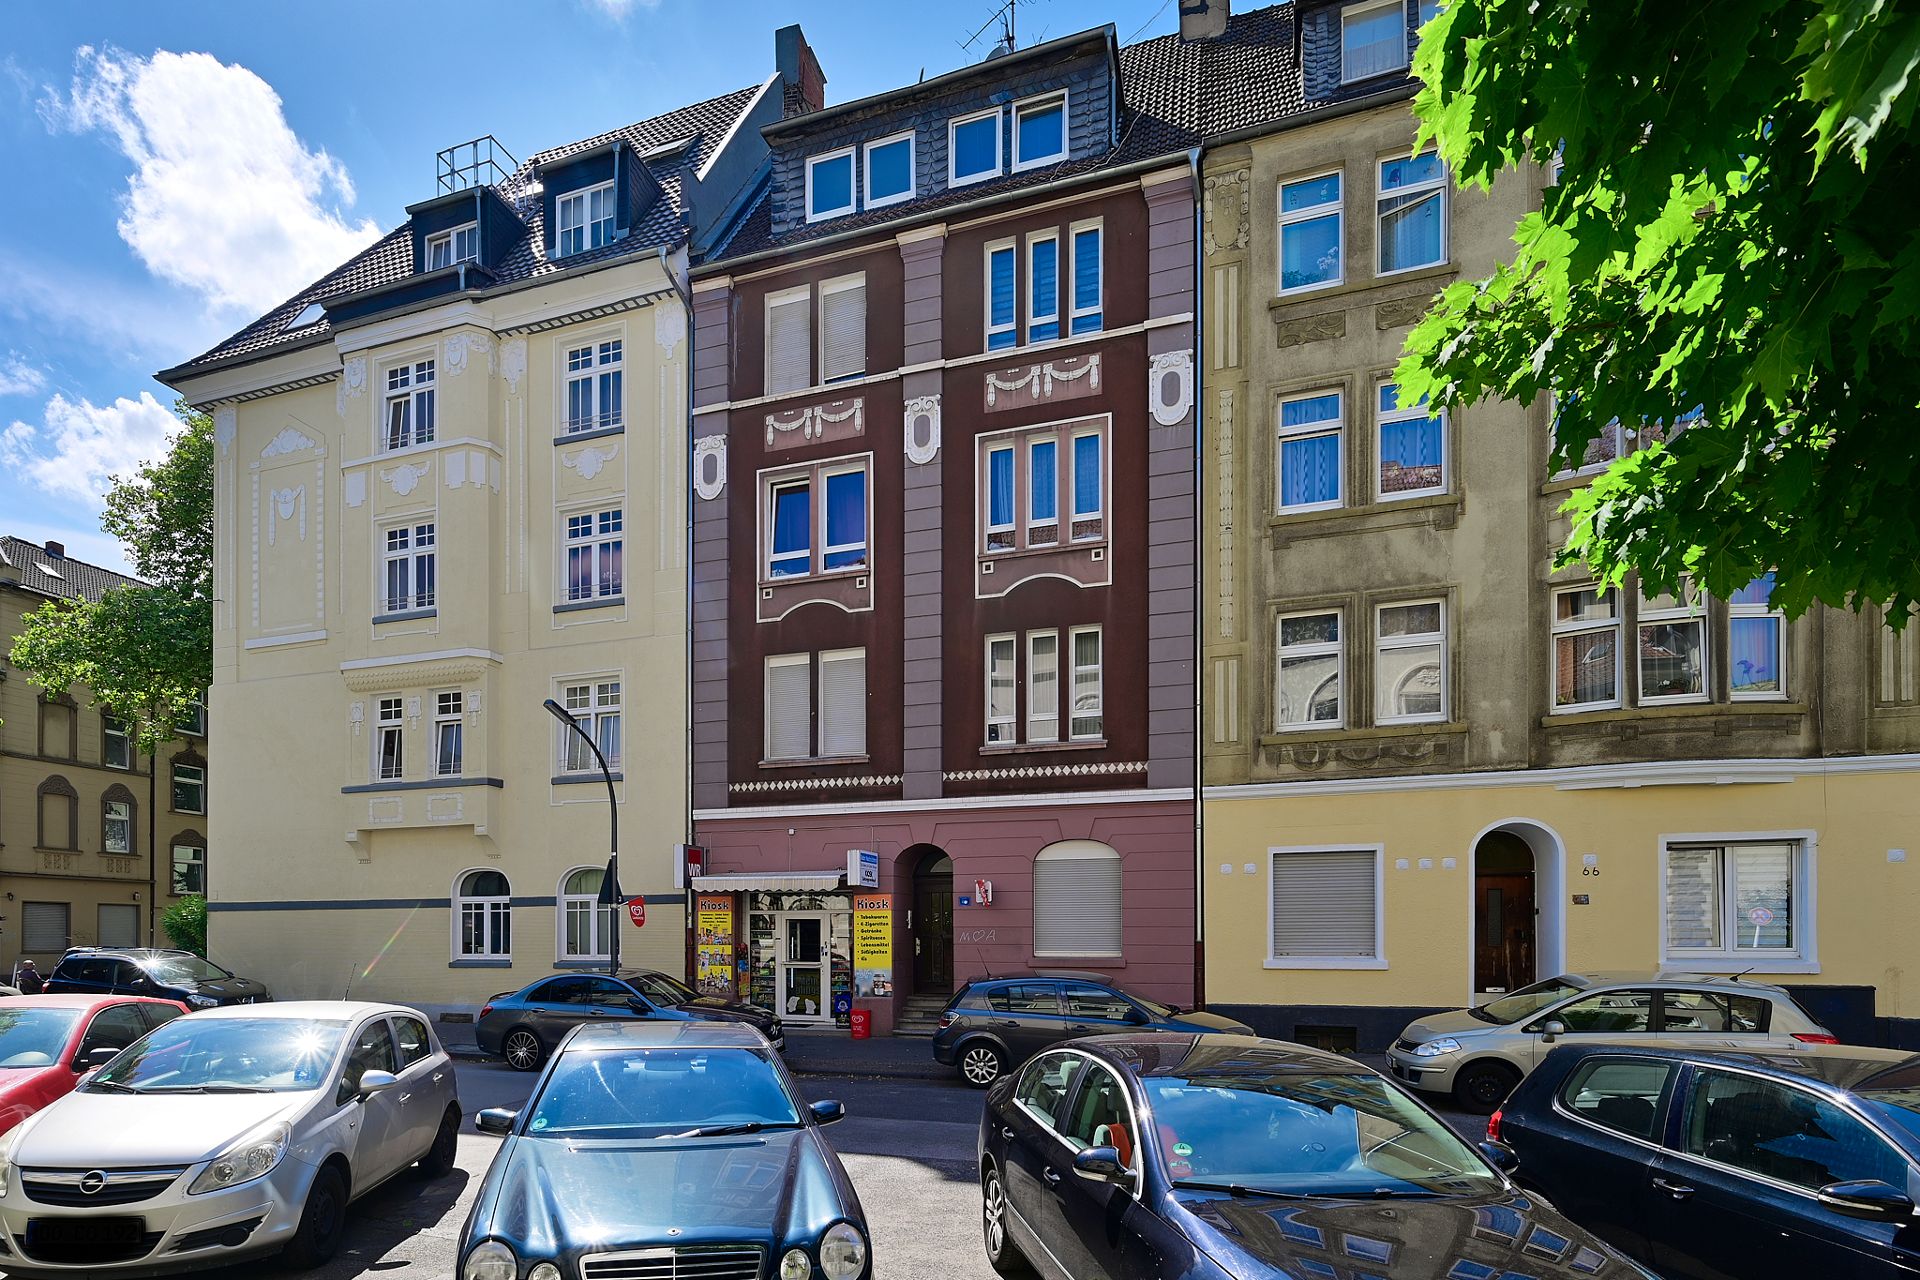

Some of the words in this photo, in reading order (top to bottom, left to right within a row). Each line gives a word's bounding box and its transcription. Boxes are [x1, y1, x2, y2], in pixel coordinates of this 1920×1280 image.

[688, 863, 701, 877] WR
[1582, 866, 1600, 876] 66
[700, 900, 729, 910] Kiosk
[857, 898, 889, 909] Kiosk
[985, 929, 996, 942] A
